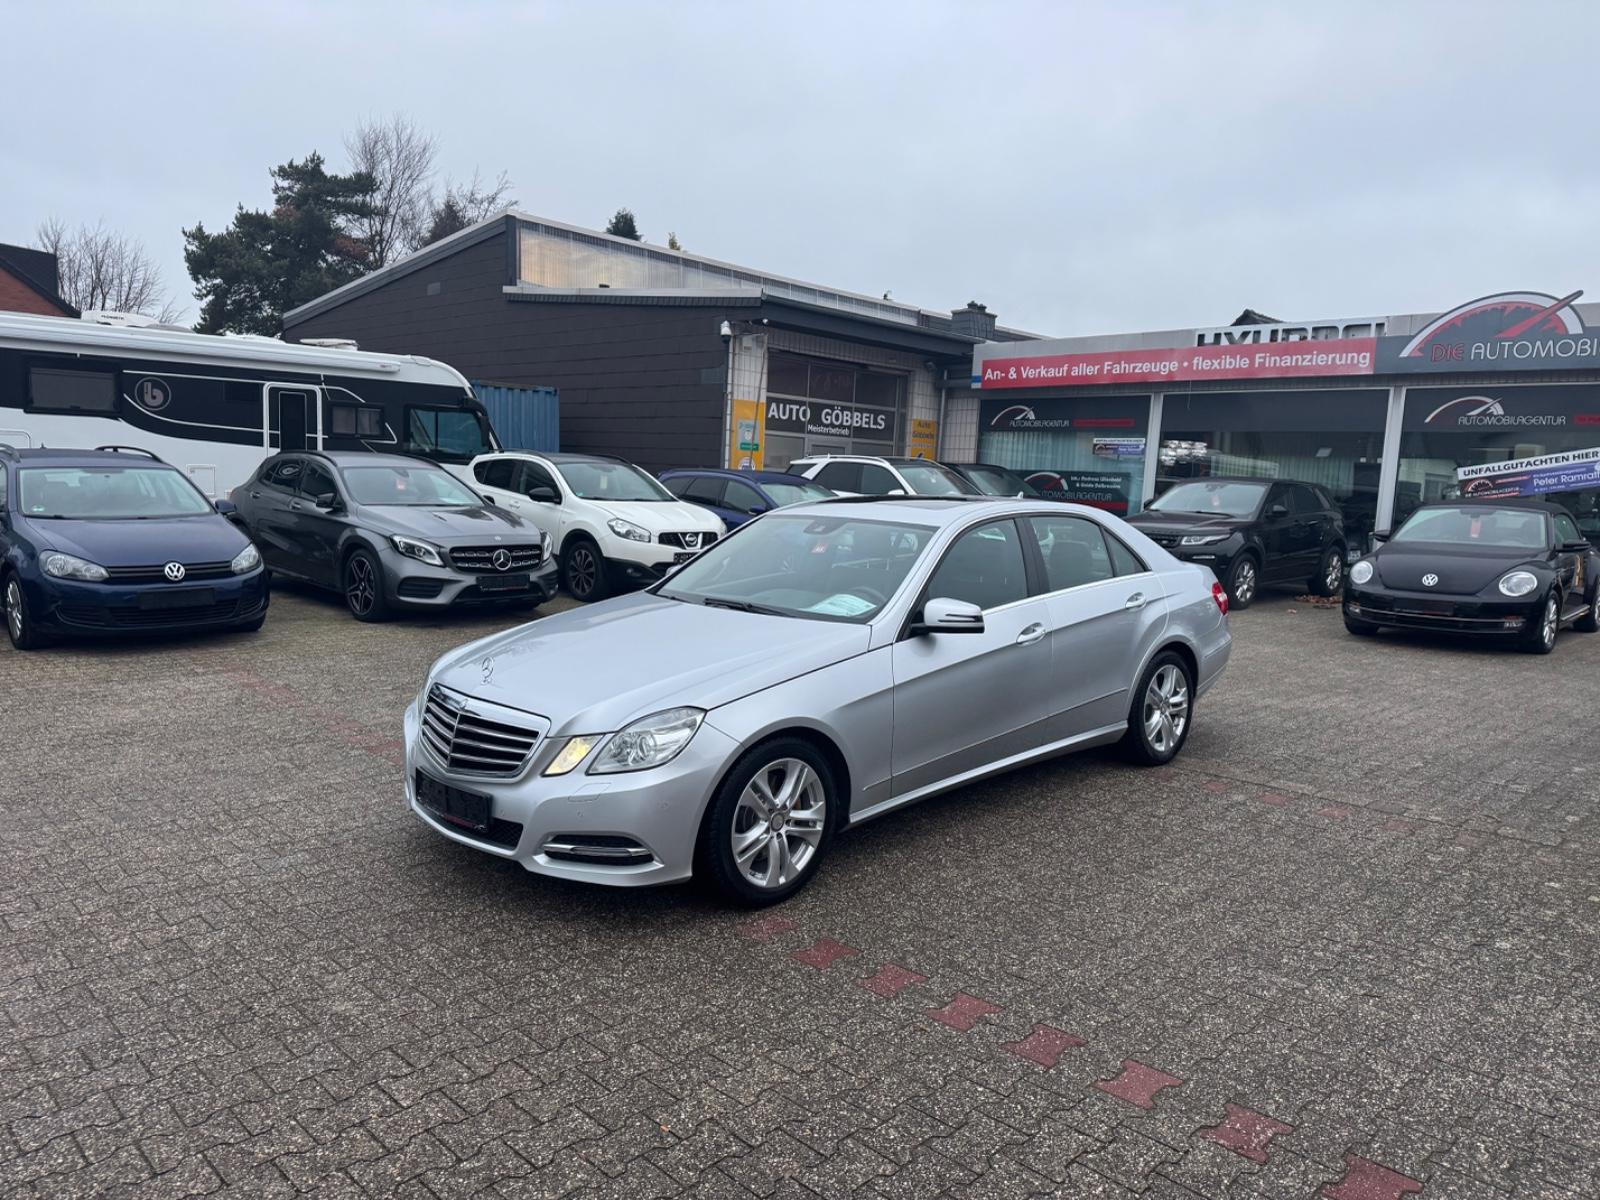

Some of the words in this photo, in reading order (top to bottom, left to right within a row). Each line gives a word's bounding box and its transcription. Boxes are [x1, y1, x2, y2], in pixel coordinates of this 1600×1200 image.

[1431, 343, 1464, 362] DIE
[1471, 338, 1600, 361] AUTOMOBI
[984, 368, 1006, 381] An-
[1008, 368, 1017, 380] &
[1021, 363, 1069, 379] Verkauf
[1071, 363, 1100, 376] aller
[1104, 359, 1179, 375] Fahrzeuge
[1193, 354, 1249, 371] flexible
[1255, 350, 1370, 368] Finanzierung
[768, 402, 811, 422] AUTO
[821, 406, 885, 430] GÖBBELS
[1458, 415, 1566, 426] AUTOMOBILAGENTUR
[808, 424, 850, 436] Meisterbetrieb
[1463, 455, 1570, 477] UNFALLGUTACHTEN
[1572, 450, 1600, 461] HIER
[1533, 476, 1558, 487] Peter
